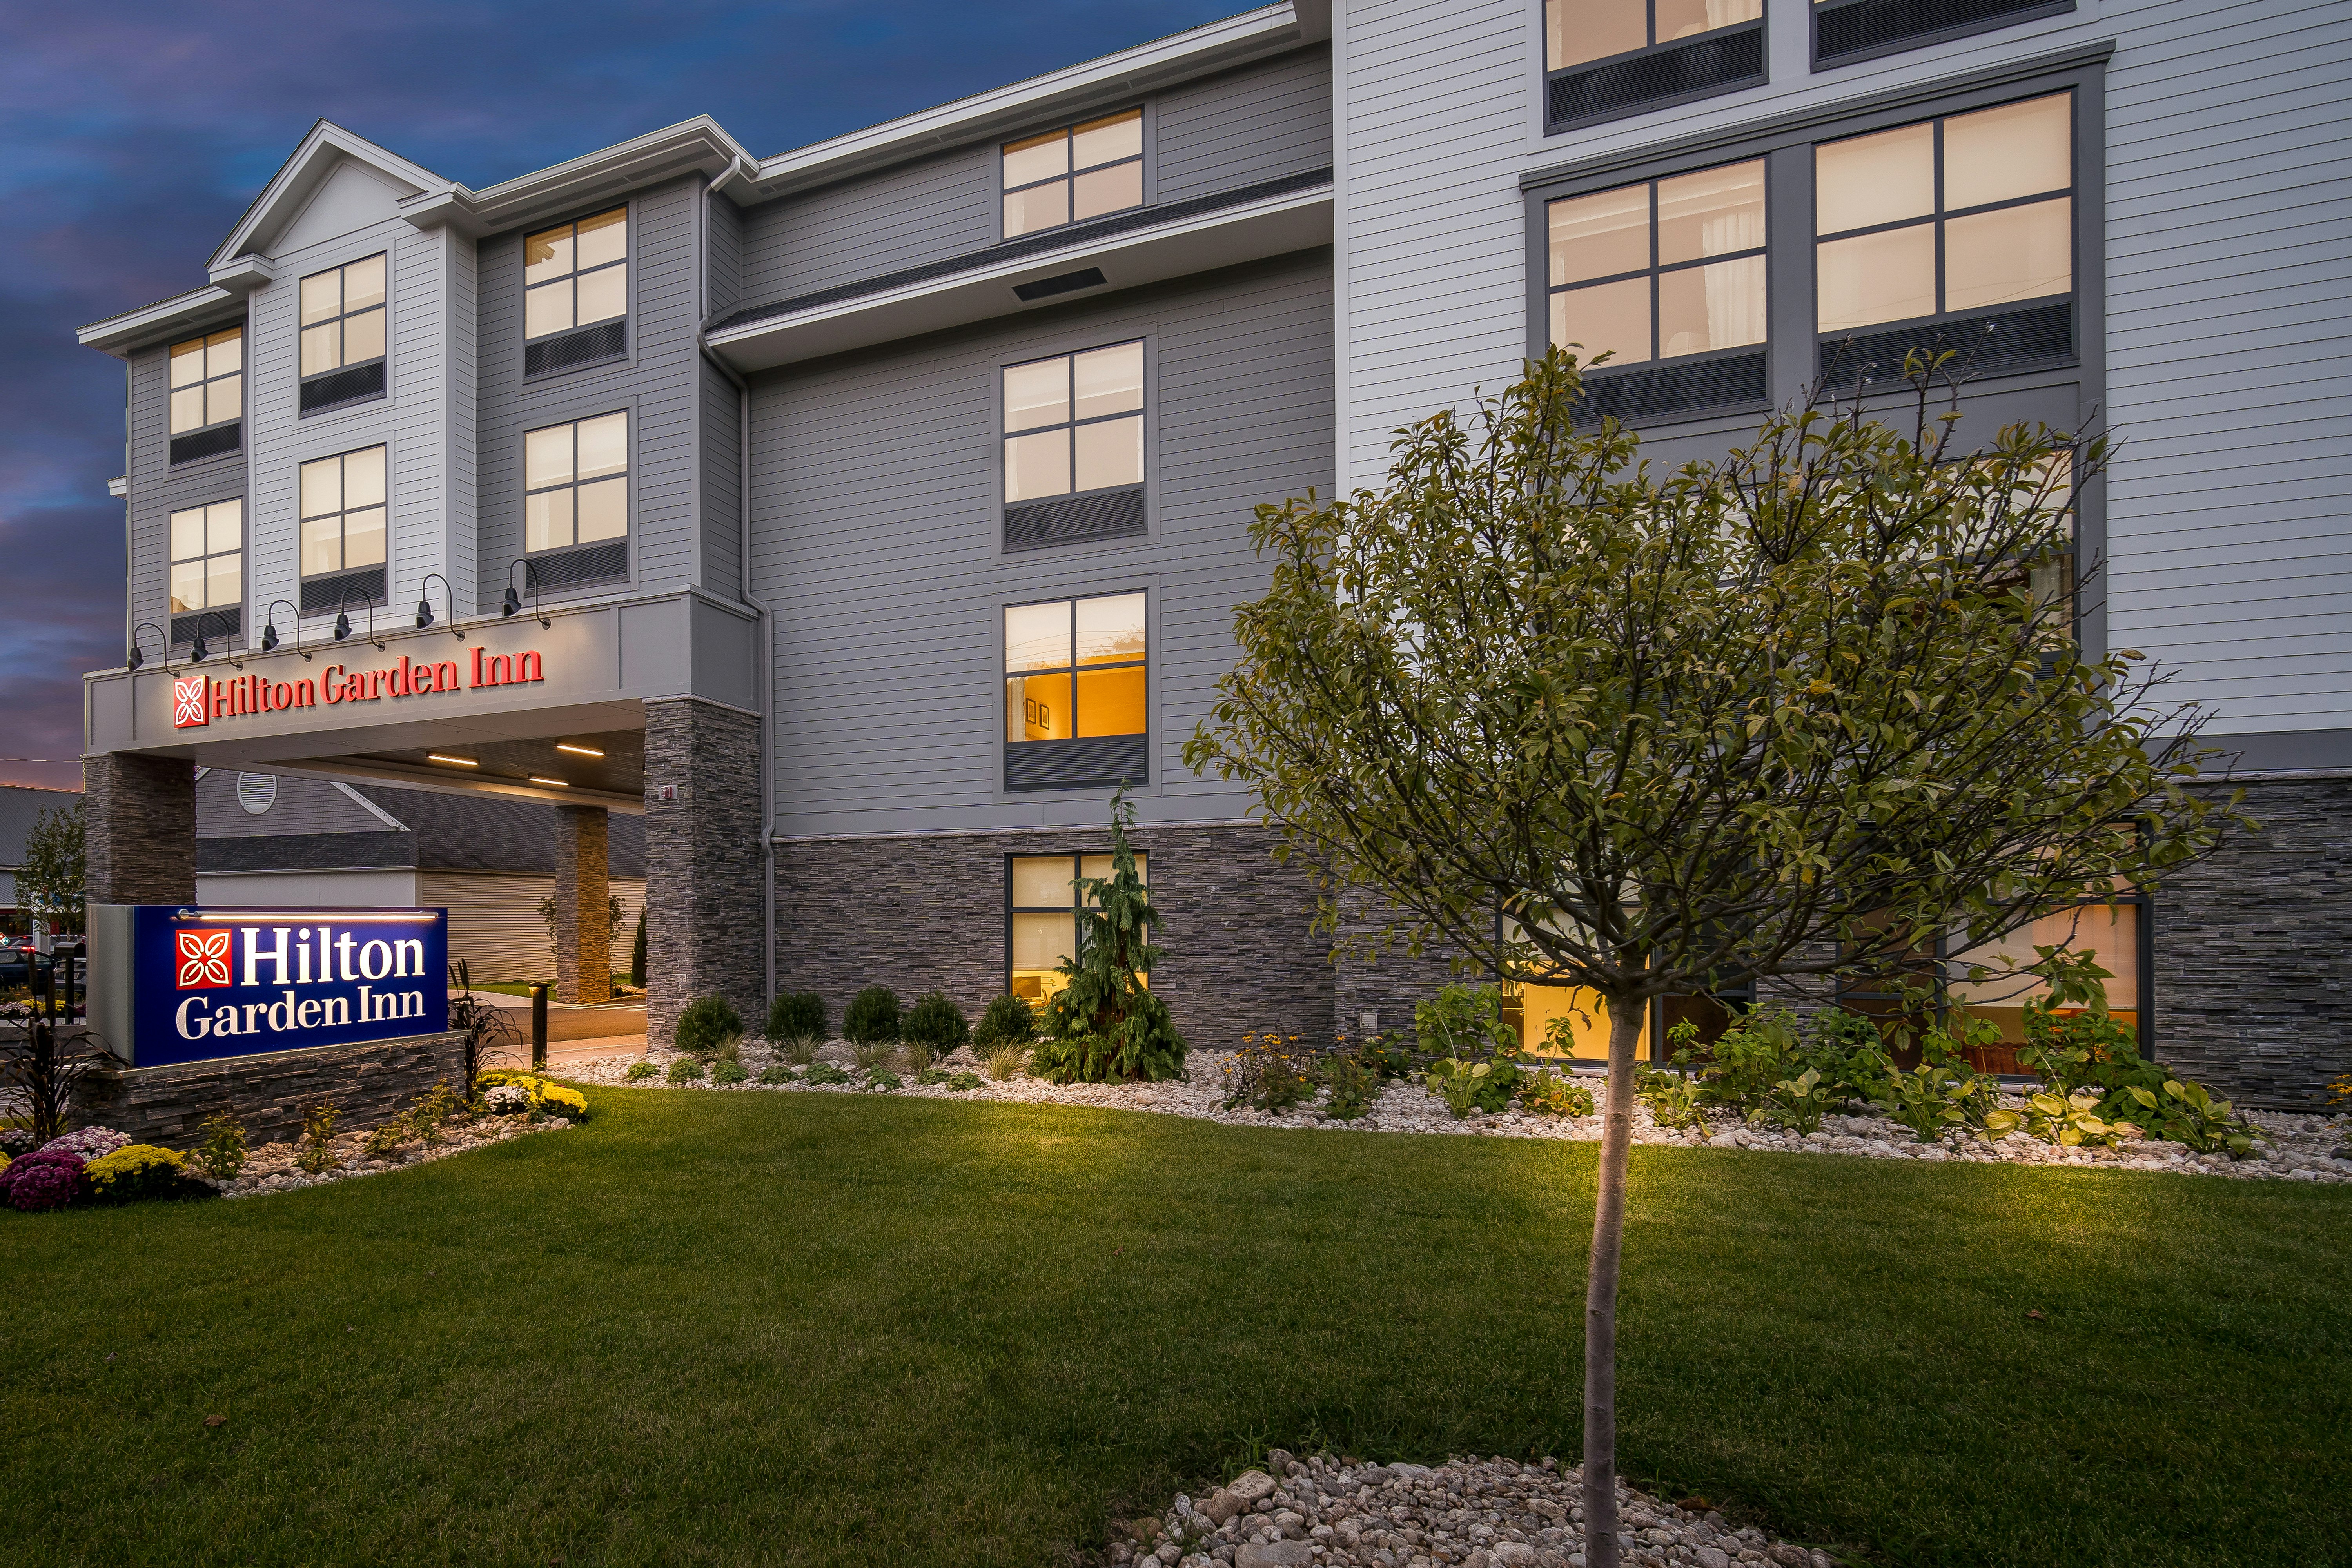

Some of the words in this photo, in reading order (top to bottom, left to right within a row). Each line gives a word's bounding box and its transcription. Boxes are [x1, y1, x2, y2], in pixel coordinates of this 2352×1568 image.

[211, 675, 316, 717] Hilton
[319, 655, 461, 705] Garden
[467, 646, 545, 688] Inn
[240, 927, 426, 986] Hilton
[176, 990, 351, 1040] Garden
[357, 985, 426, 1022] Inn
